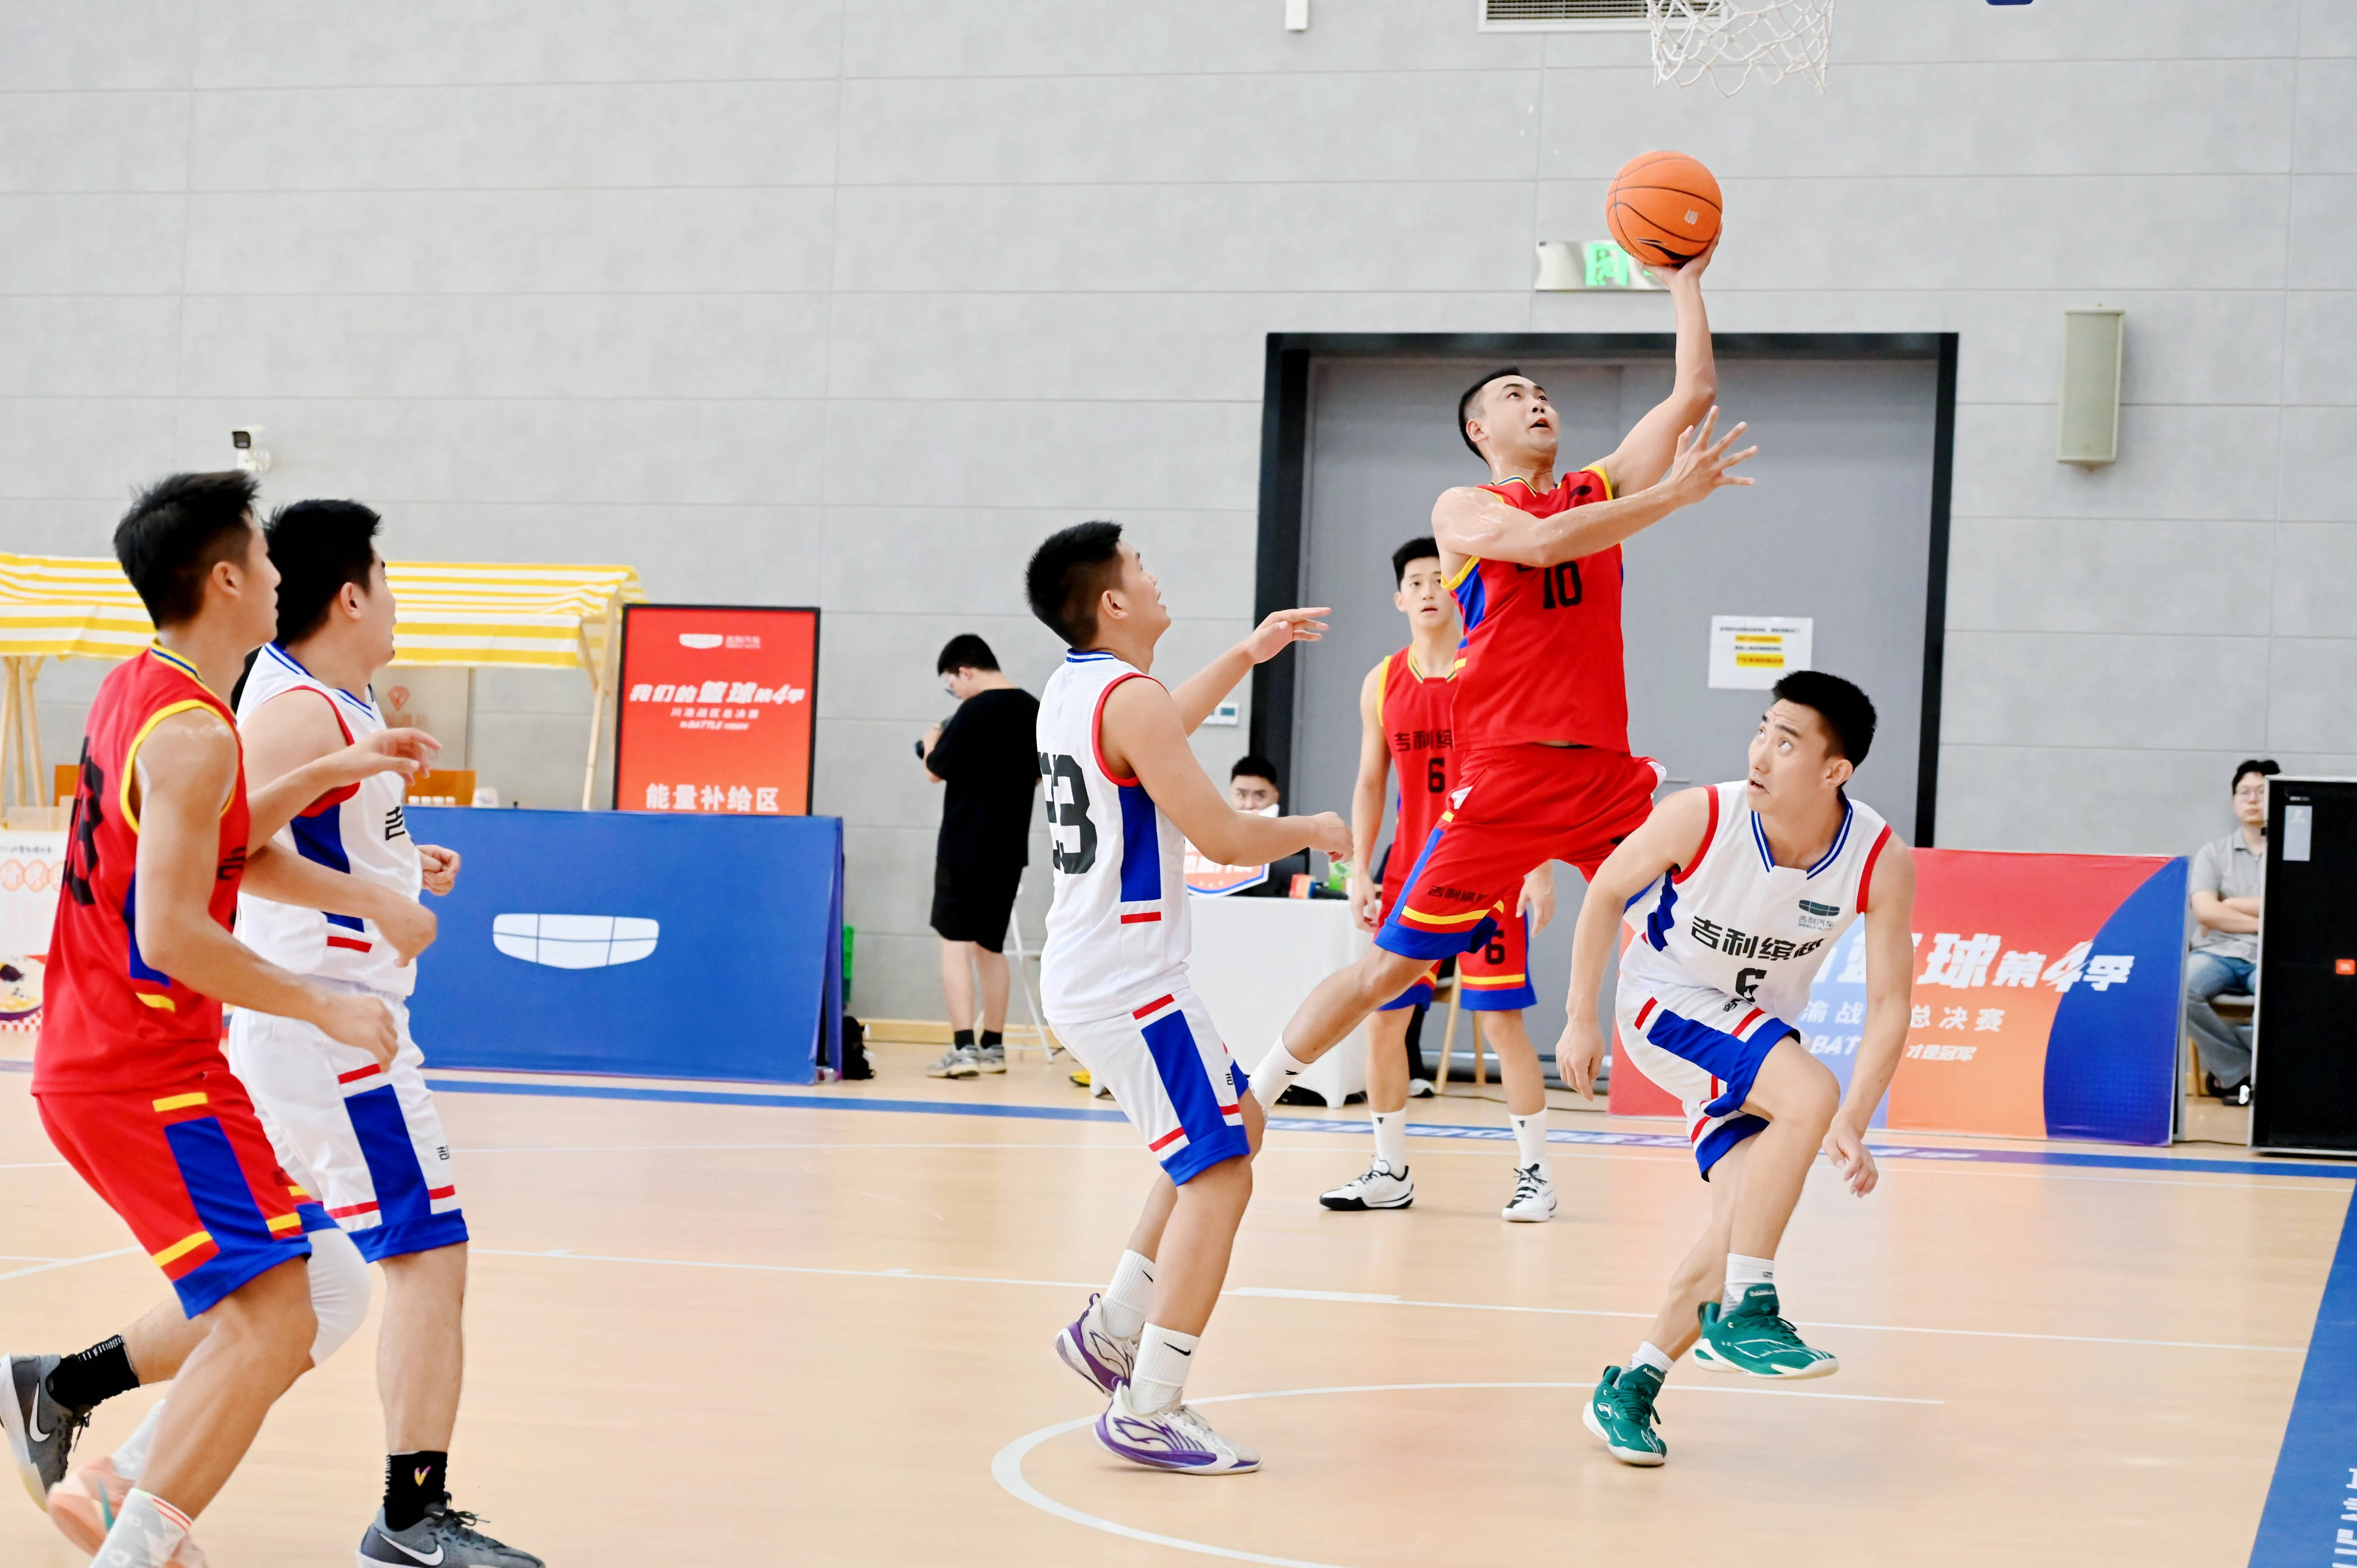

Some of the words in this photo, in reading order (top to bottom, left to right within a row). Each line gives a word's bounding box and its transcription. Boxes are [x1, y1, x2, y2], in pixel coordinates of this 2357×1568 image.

[1543, 561, 1583, 609] 10
[1428, 758, 1445, 793] 6
[646, 783, 779, 812] 能量补给区
[1799, 915, 1834, 927] 吉利汽车
[1485, 929, 1505, 965] 6
[1812, 933, 2135, 992] 球第4季
[1809, 1034, 1863, 1056] BAT
